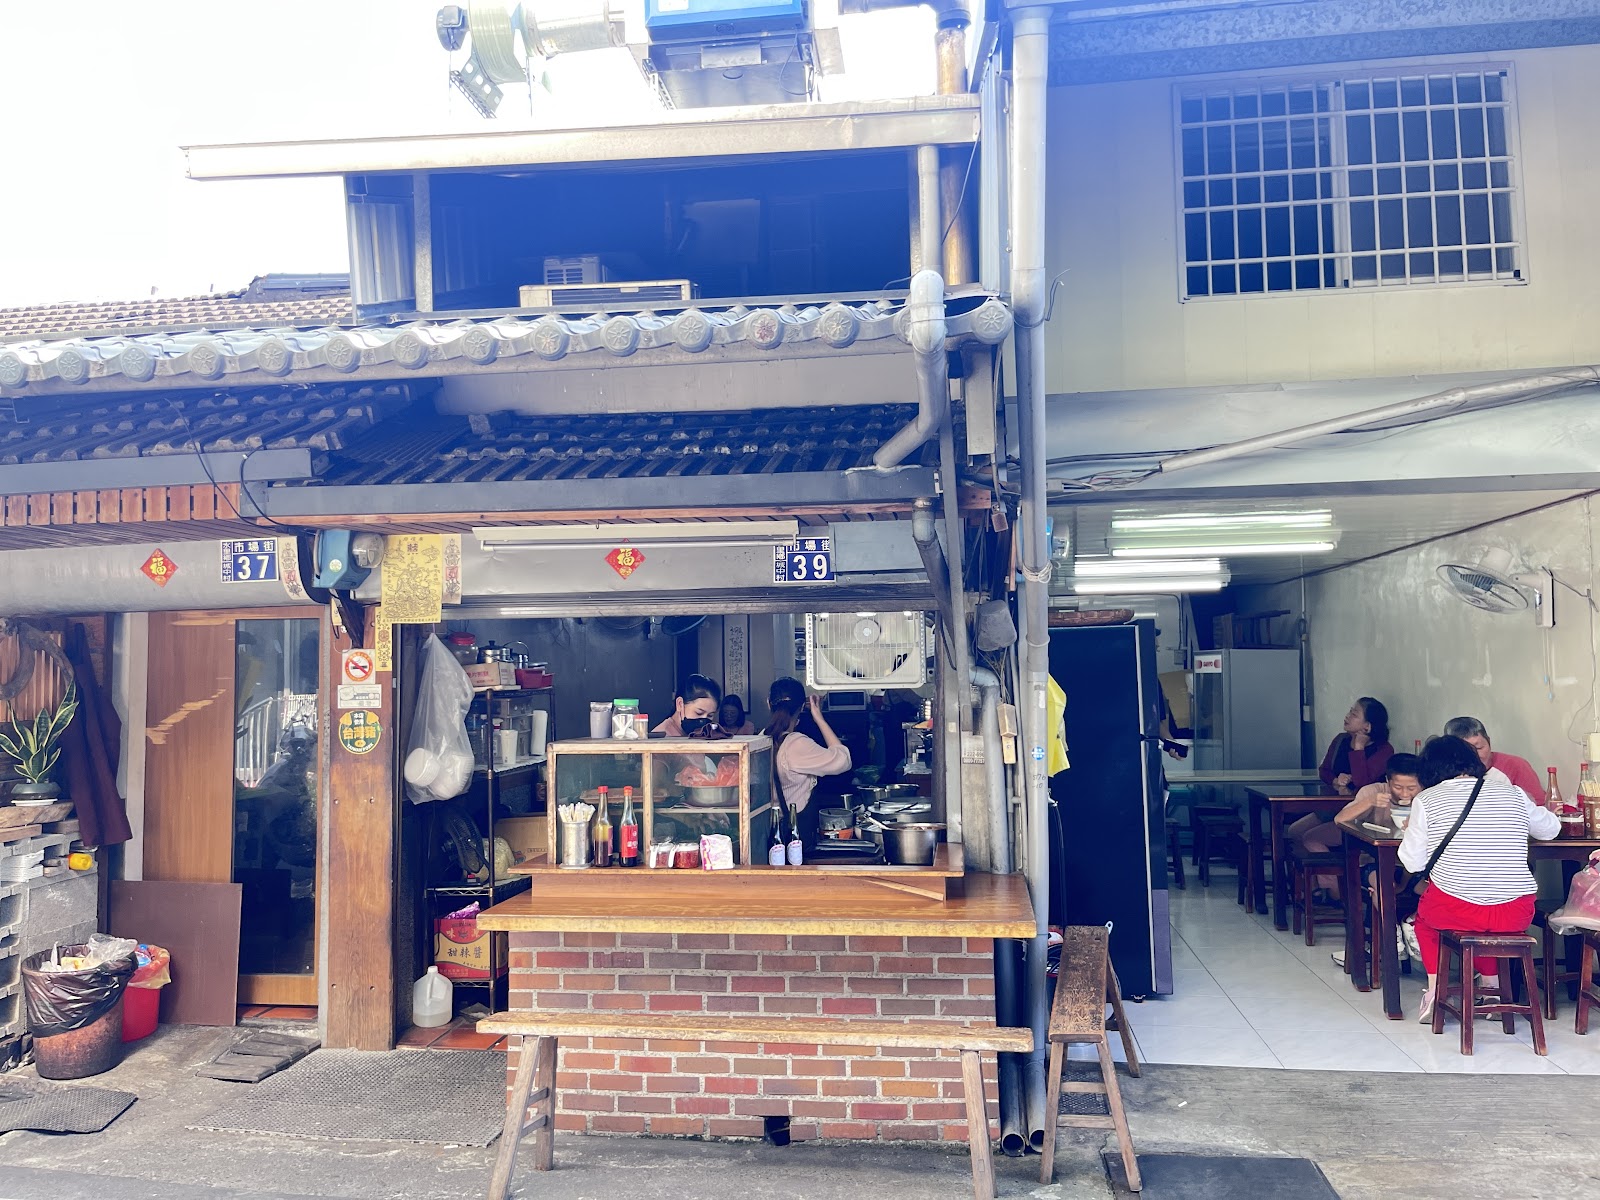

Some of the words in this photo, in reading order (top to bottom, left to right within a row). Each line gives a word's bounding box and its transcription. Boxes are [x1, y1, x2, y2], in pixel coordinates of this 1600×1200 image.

[234, 541, 274, 553] 市場街
[617, 548, 635, 566] 福
[150, 557, 167, 576] 福
[238, 555, 269, 580] 37
[793, 554, 827, 580] 39
[343, 726, 376, 740] 台灣豬
[447, 946, 482, 959] 甜辣醬
